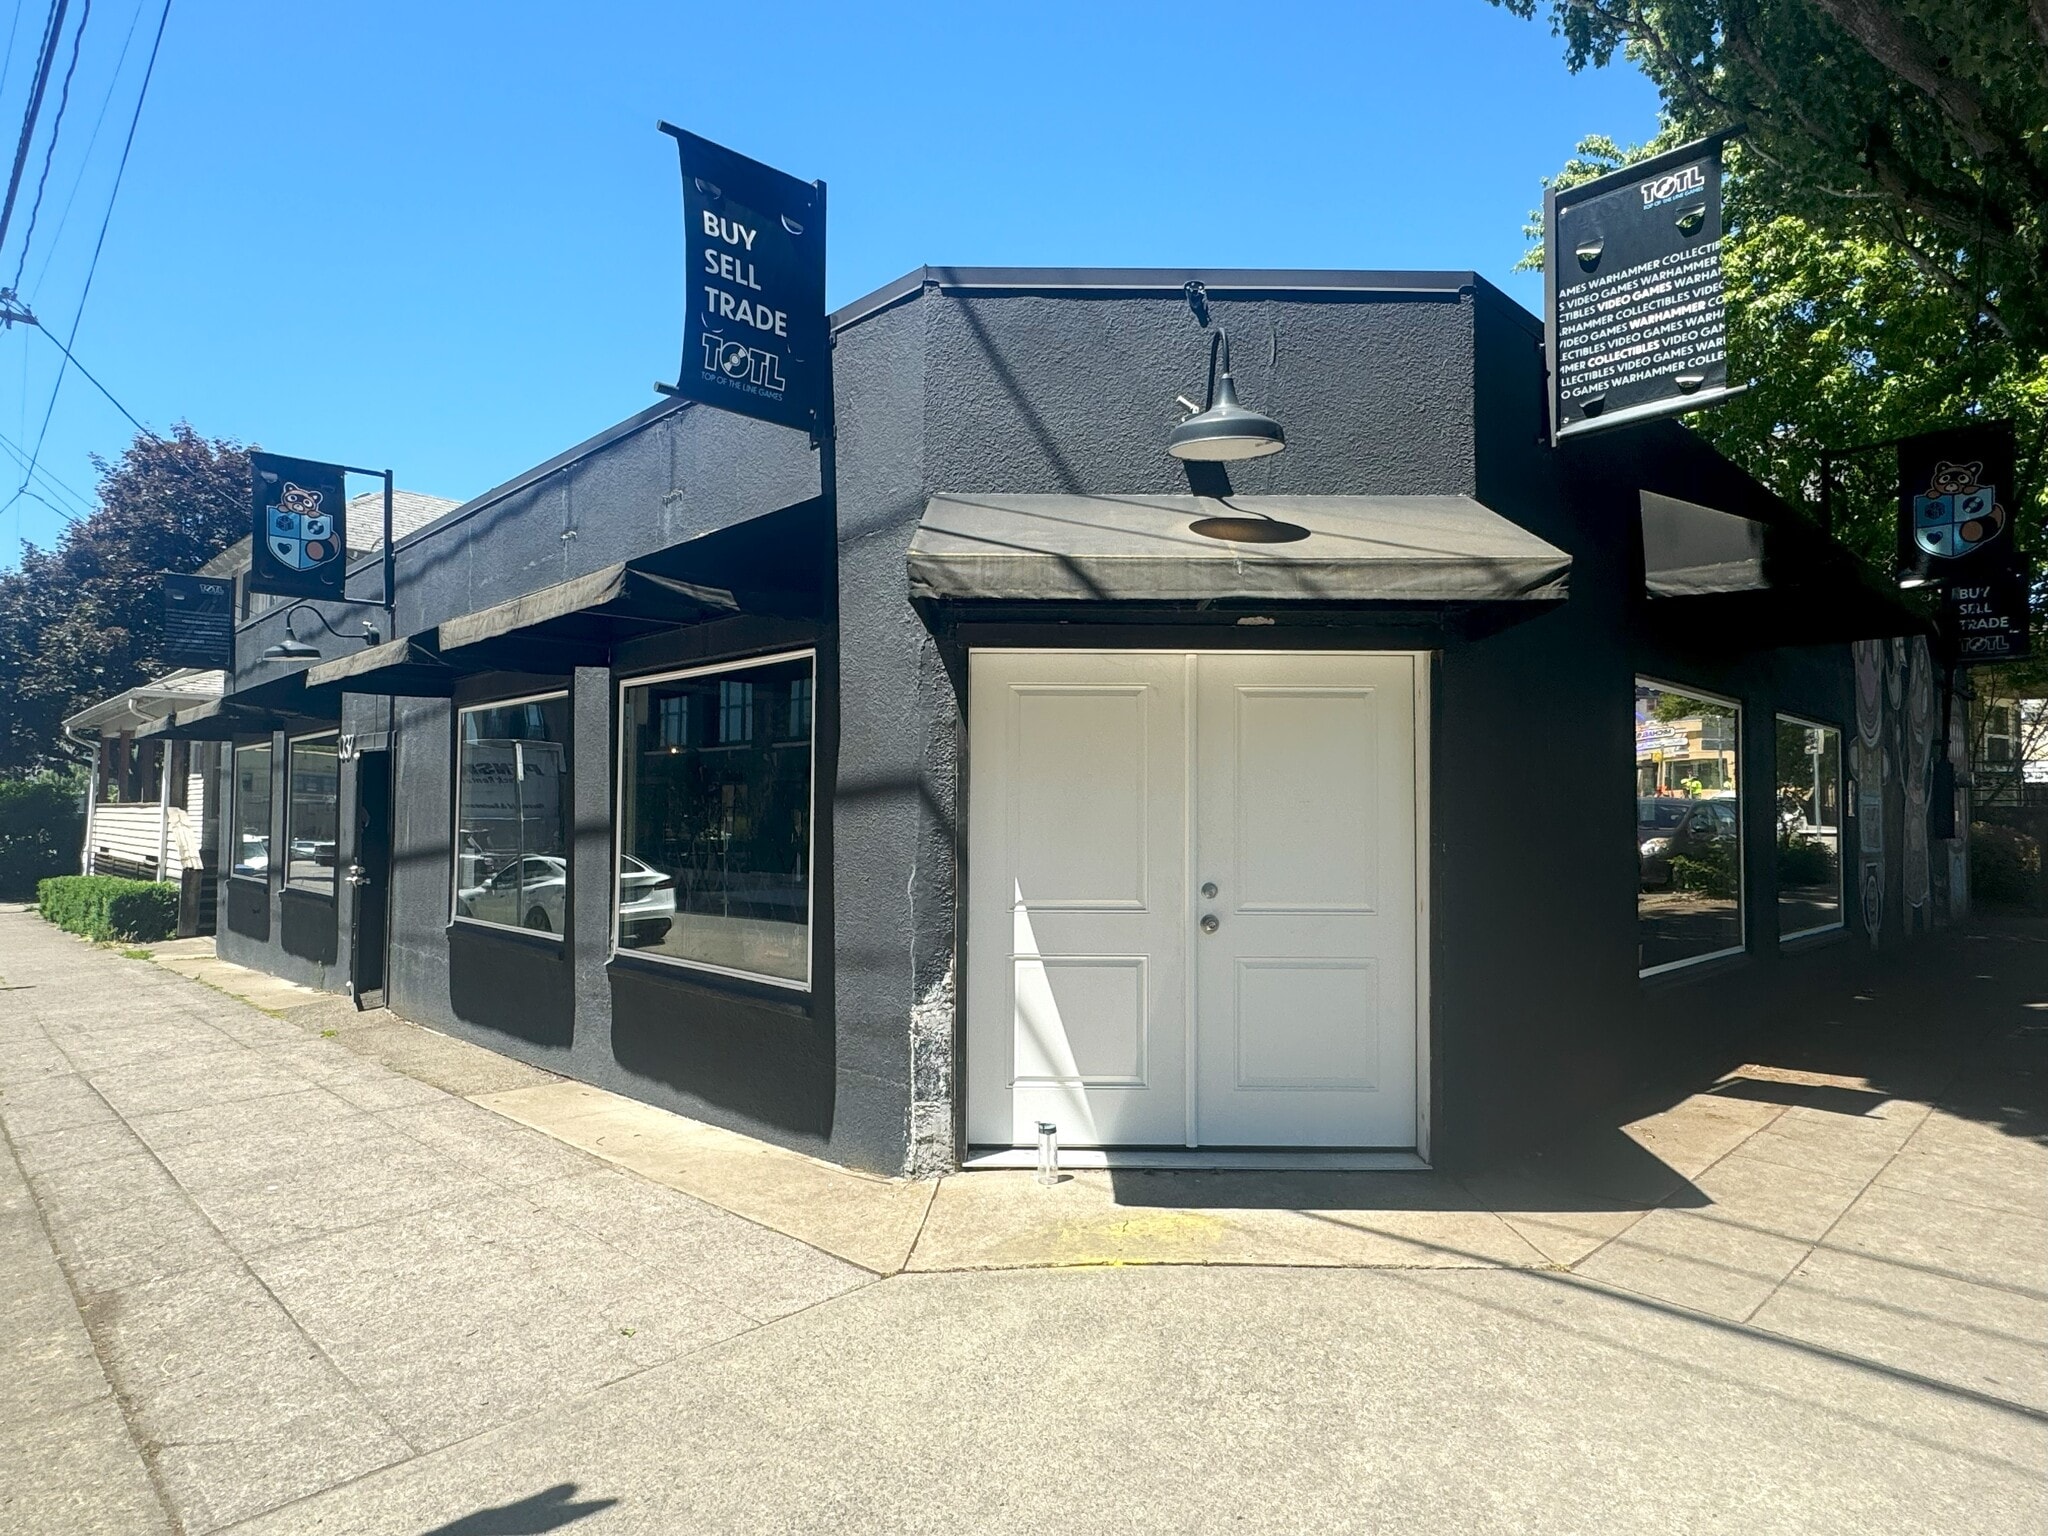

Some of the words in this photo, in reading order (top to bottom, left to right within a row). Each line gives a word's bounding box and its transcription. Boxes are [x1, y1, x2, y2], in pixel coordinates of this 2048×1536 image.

[1641, 166, 1705, 204] TOTL
[1684, 186, 1704, 197] GAMES
[703, 210, 757, 251] BUY
[704, 248, 761, 291] SELL
[1559, 302, 1565, 311] S
[1567, 293, 1599, 308] VIDEO
[1601, 280, 1639, 298] GAMES
[1640, 256, 1718, 286] WARHAMMER
[1588, 260, 1660, 289] WARHAMMER
[704, 286, 787, 338] TRADE
[1559, 314, 1614, 336] RHAMMER
[1616, 291, 1690, 320] COLLECTIBLES
[1597, 294, 1631, 312] VIDEO
[1632, 281, 1672, 301] GAMES
[1590, 323, 1627, 340] GAMES
[1629, 301, 1706, 330] WARHAMMER
[1708, 295, 1724, 307] CO
[1560, 342, 1606, 361] ECTIBLES
[1607, 332, 1641, 348] VIDEO
[1643, 321, 1683, 338] GAMES
[1587, 340, 1660, 367] COLLECTIBLES
[1661, 331, 1698, 347] VIDEO
[702, 333, 785, 391] TOTL
[1561, 390, 1571, 400] O
[1572, 380, 1609, 397] GAMES
[1611, 361, 1685, 387] WARHAMMER
[1562, 366, 1615, 387] LLECTIBLES
[1617, 357, 1651, 372] VIDEO
[1653, 345, 1693, 362] GAMES
[701, 371, 716, 381] TOP
[717, 376, 727, 385] OF
[729, 380, 741, 389] THE
[742, 384, 757, 394] LINE
[758, 388, 783, 401] GAMES
[1959, 602, 1992, 615] SELL
[1960, 586, 1990, 600] BUY
[1959, 616, 2009, 630] TRADE
[1959, 635, 2009, 652] TOTL
